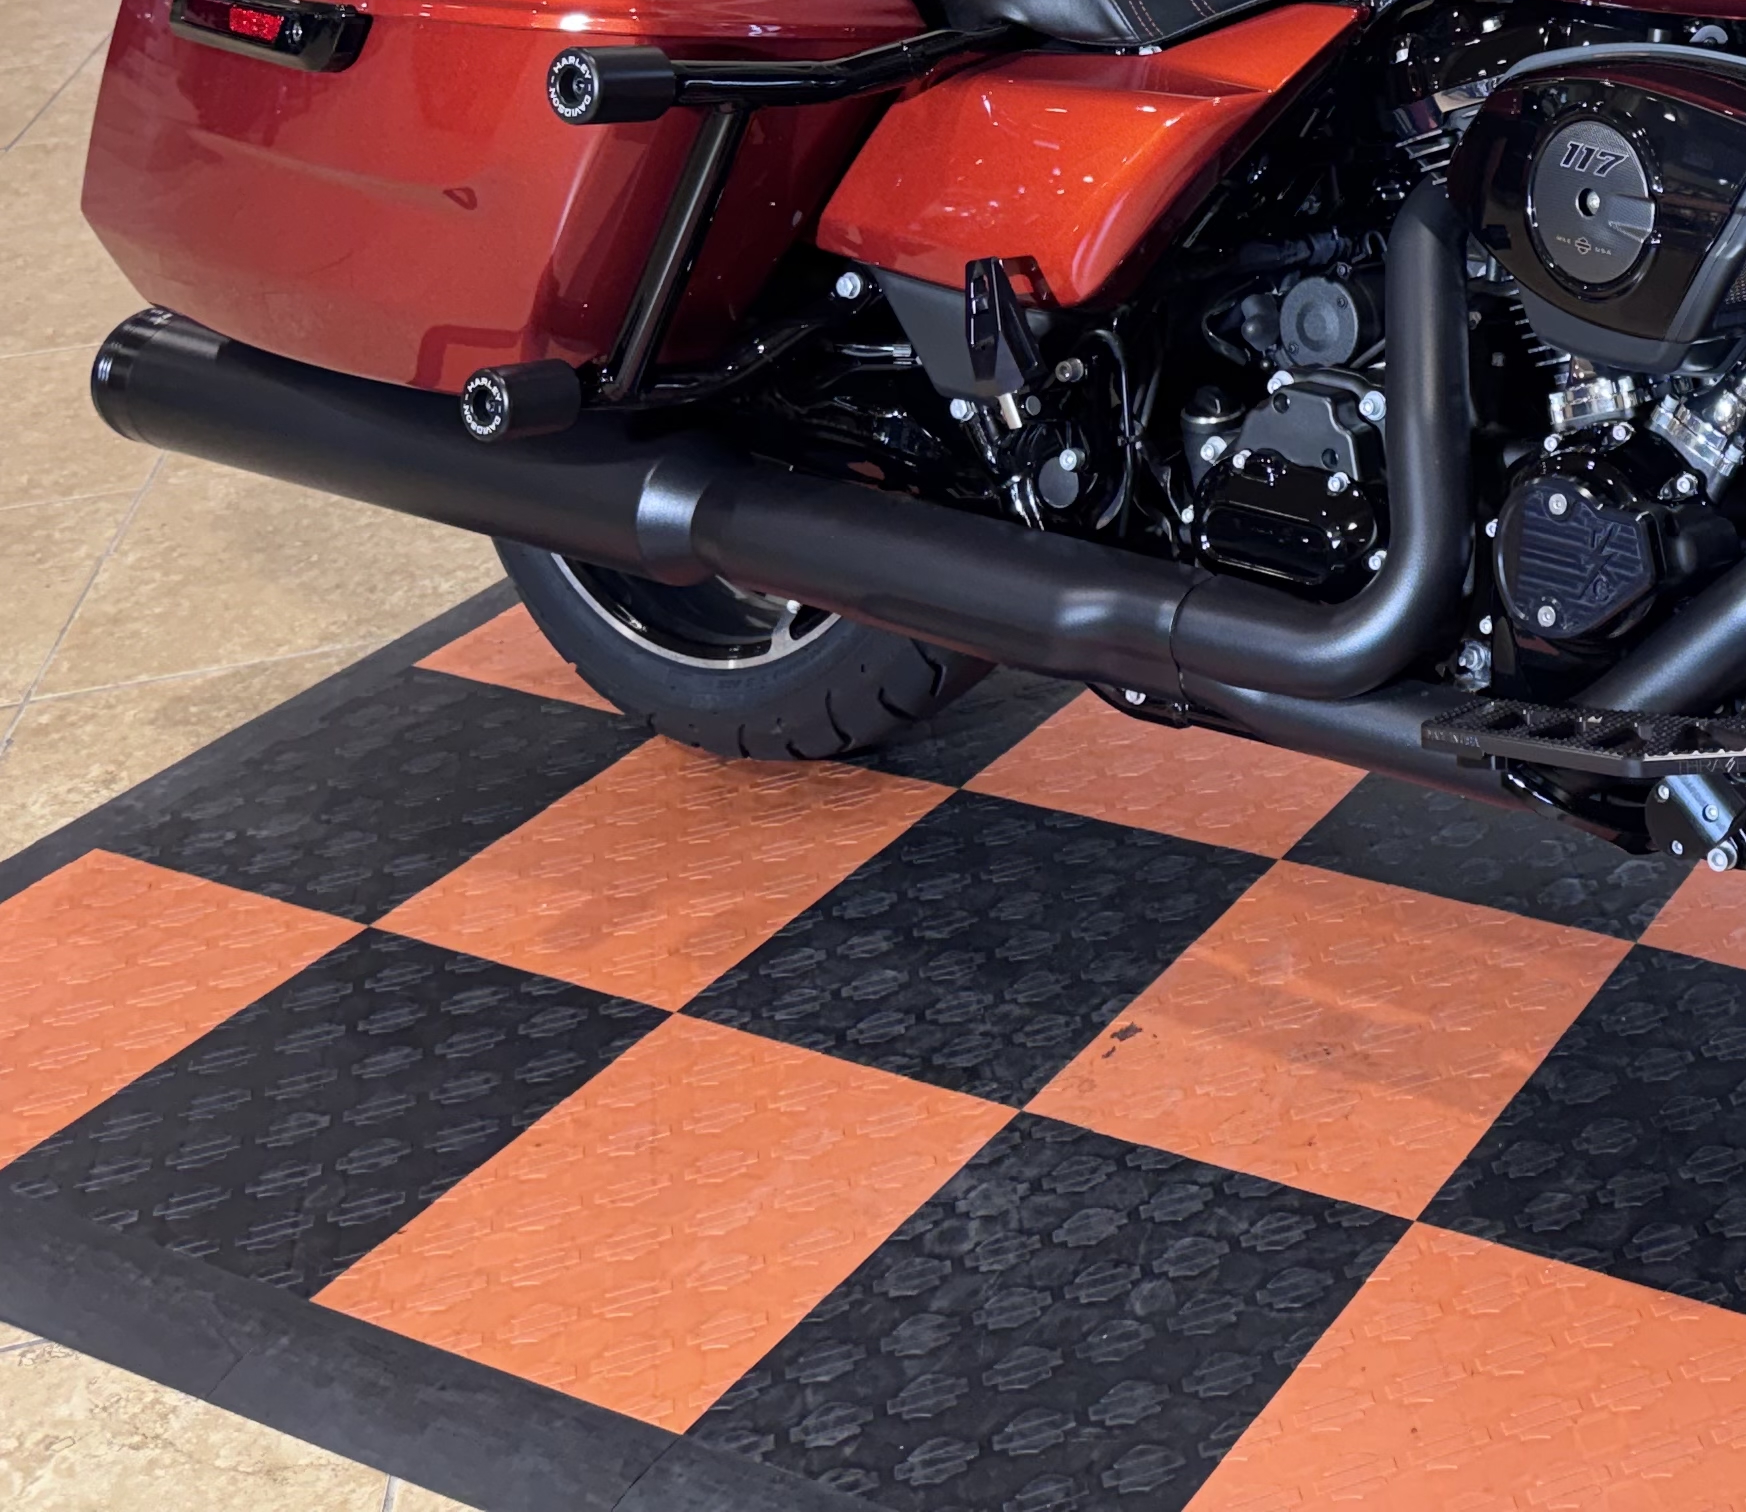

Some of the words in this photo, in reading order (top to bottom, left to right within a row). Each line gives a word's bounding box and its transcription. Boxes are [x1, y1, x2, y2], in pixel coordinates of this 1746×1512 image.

[552, 55, 592, 79] HARLEY
[549, 86, 592, 118] DAVIDSON
[1560, 140, 1629, 178] 117
[466, 376, 503, 402] HARLEY
[463, 403, 502, 435] DAVIDSON
